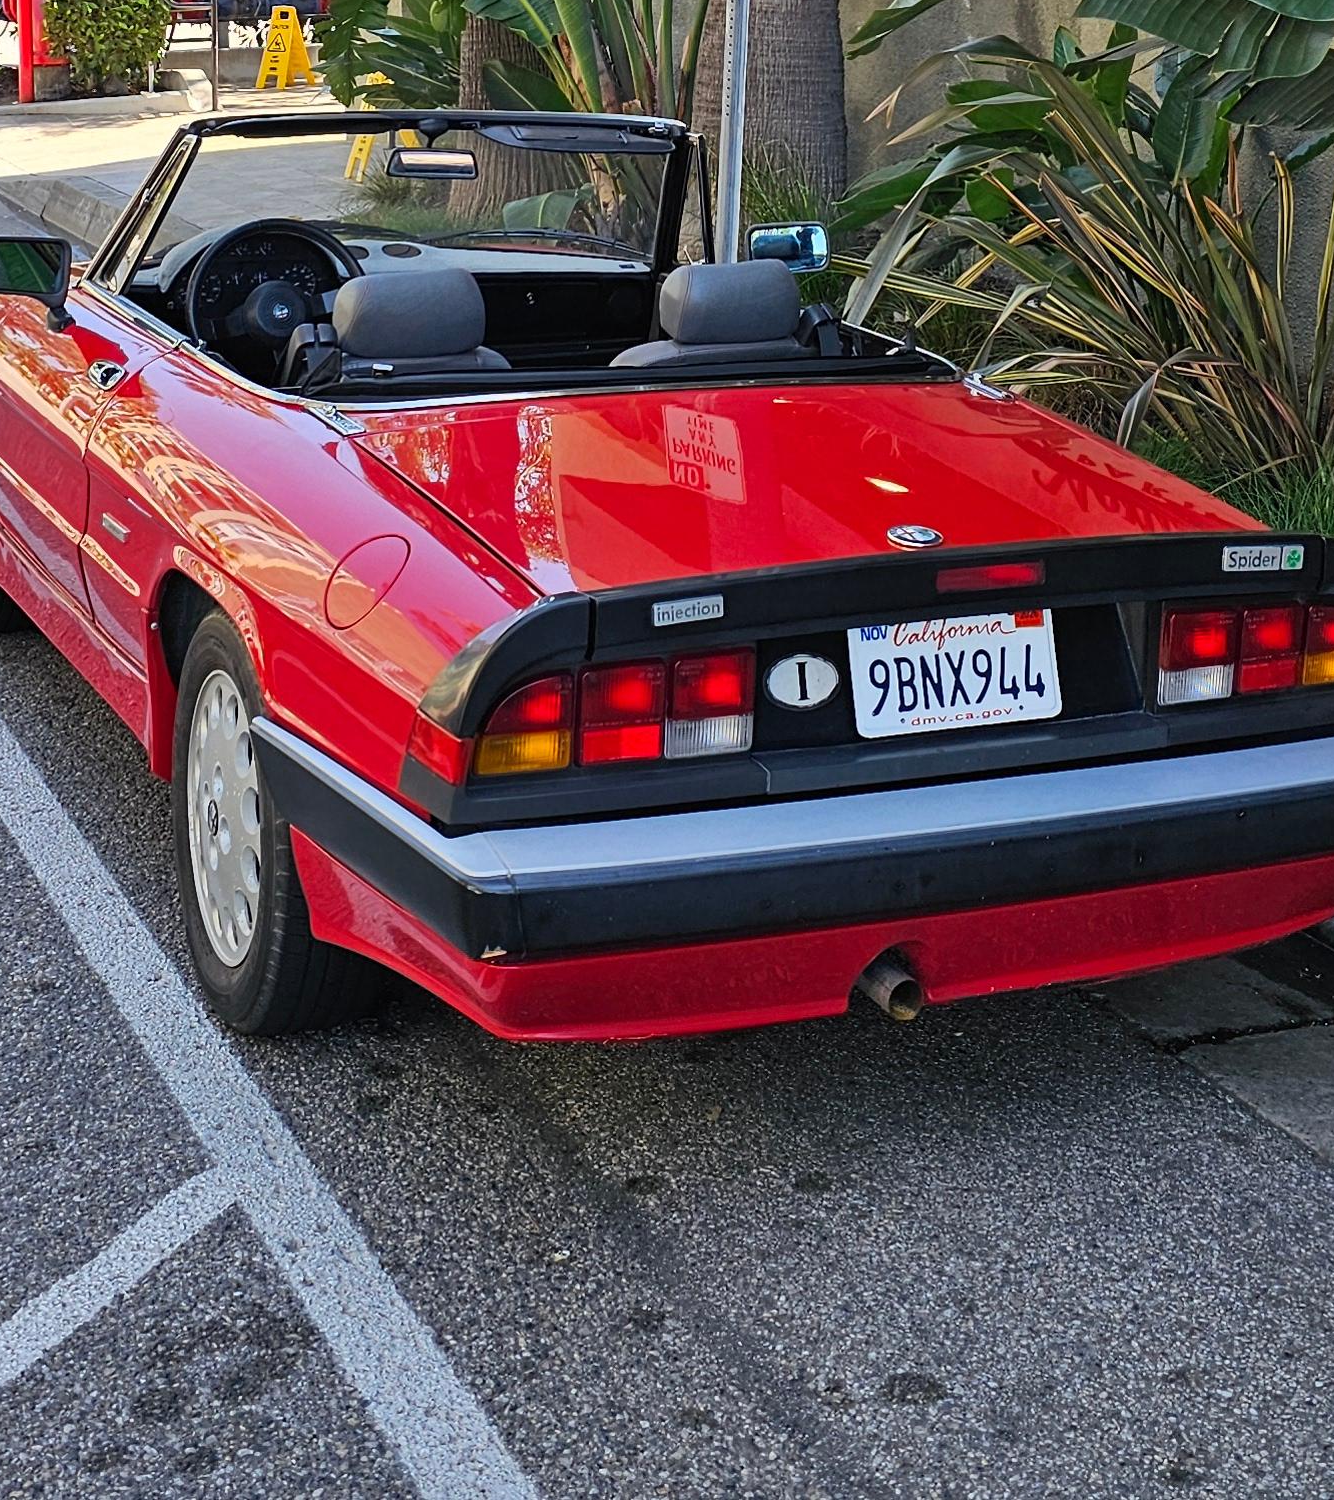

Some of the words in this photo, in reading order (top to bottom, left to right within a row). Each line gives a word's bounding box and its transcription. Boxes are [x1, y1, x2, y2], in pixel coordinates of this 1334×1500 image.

[1228, 550, 1277, 569] Spider
[657, 601, 720, 621] injection
[860, 626, 887, 642] NOV
[893, 618, 1016, 651] California
[795, 661, 810, 701] I
[869, 644, 1046, 717] 9BNX944
[911, 707, 1013, 727] dmv.ca.gov
